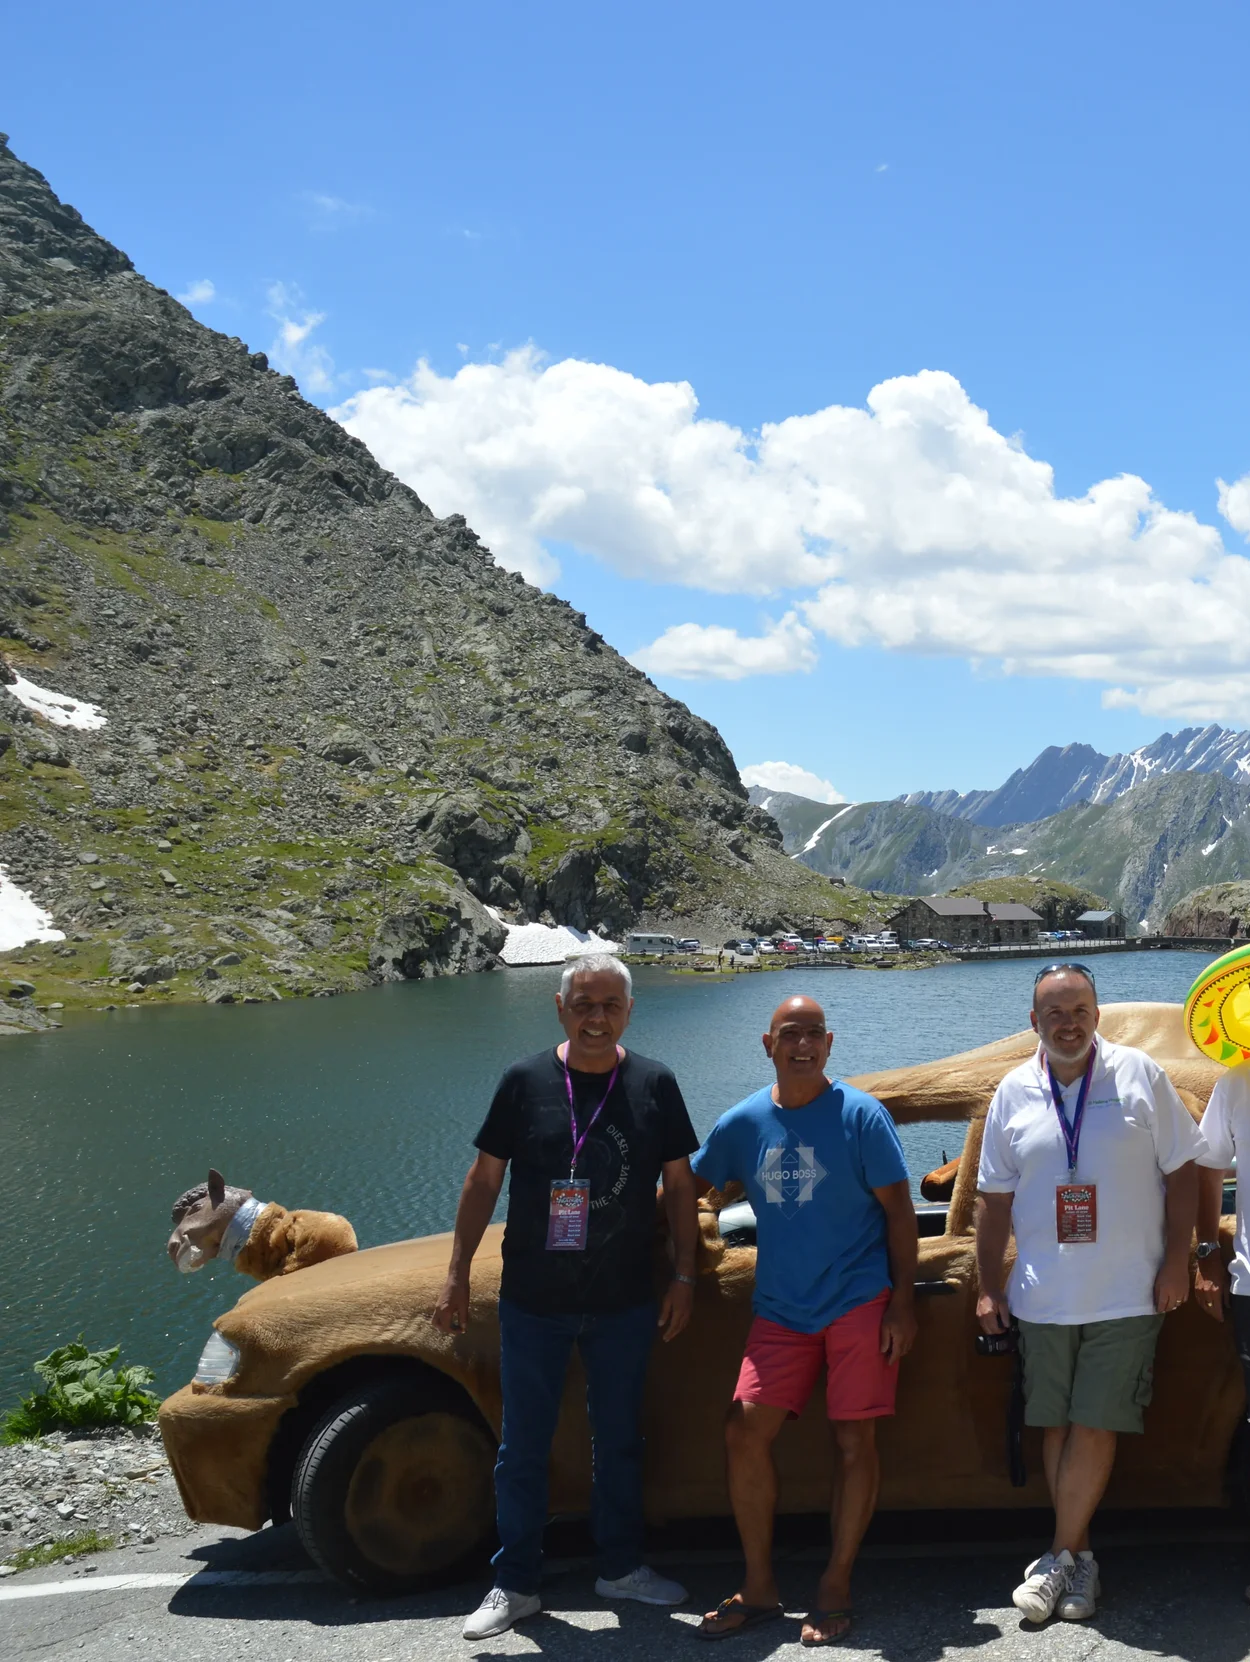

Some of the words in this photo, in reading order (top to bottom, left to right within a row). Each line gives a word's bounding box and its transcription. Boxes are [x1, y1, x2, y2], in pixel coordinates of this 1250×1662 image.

[606, 1124, 629, 1156] DIESEL
[590, 1196, 609, 1210] THE
[612, 1164, 630, 1195] BRAVE
[761, 1170, 790, 1181] HUGO
[792, 1169, 816, 1179] BOSS
